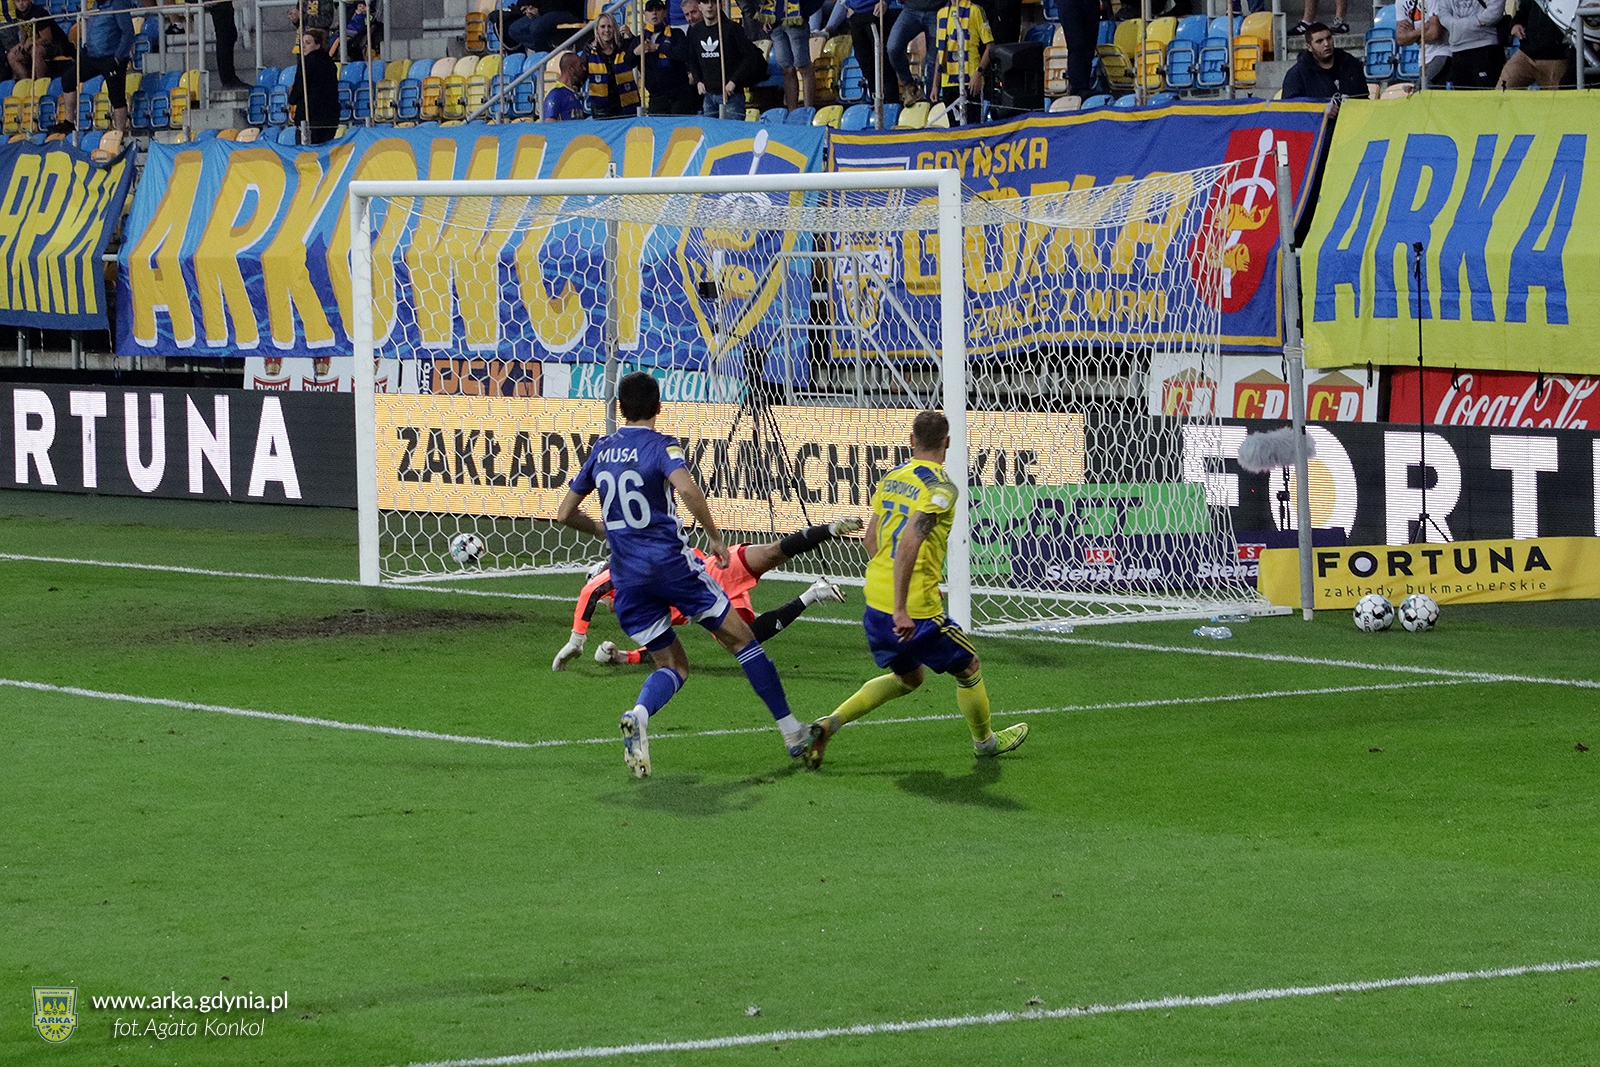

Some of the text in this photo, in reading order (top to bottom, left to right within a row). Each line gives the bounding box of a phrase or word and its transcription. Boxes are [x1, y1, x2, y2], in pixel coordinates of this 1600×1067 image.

[128, 126, 703, 353] ARKOWCY
[1313, 133, 1587, 325] ARKA
[597, 448, 639, 463] MUSA
[595, 469, 651, 531] 26
[1182, 424, 1600, 548] FORT
[880, 500, 910, 558] 77
[1317, 546, 1552, 578] FORTUNA
[1324, 579, 1547, 599] zakłady bukmacherskie
